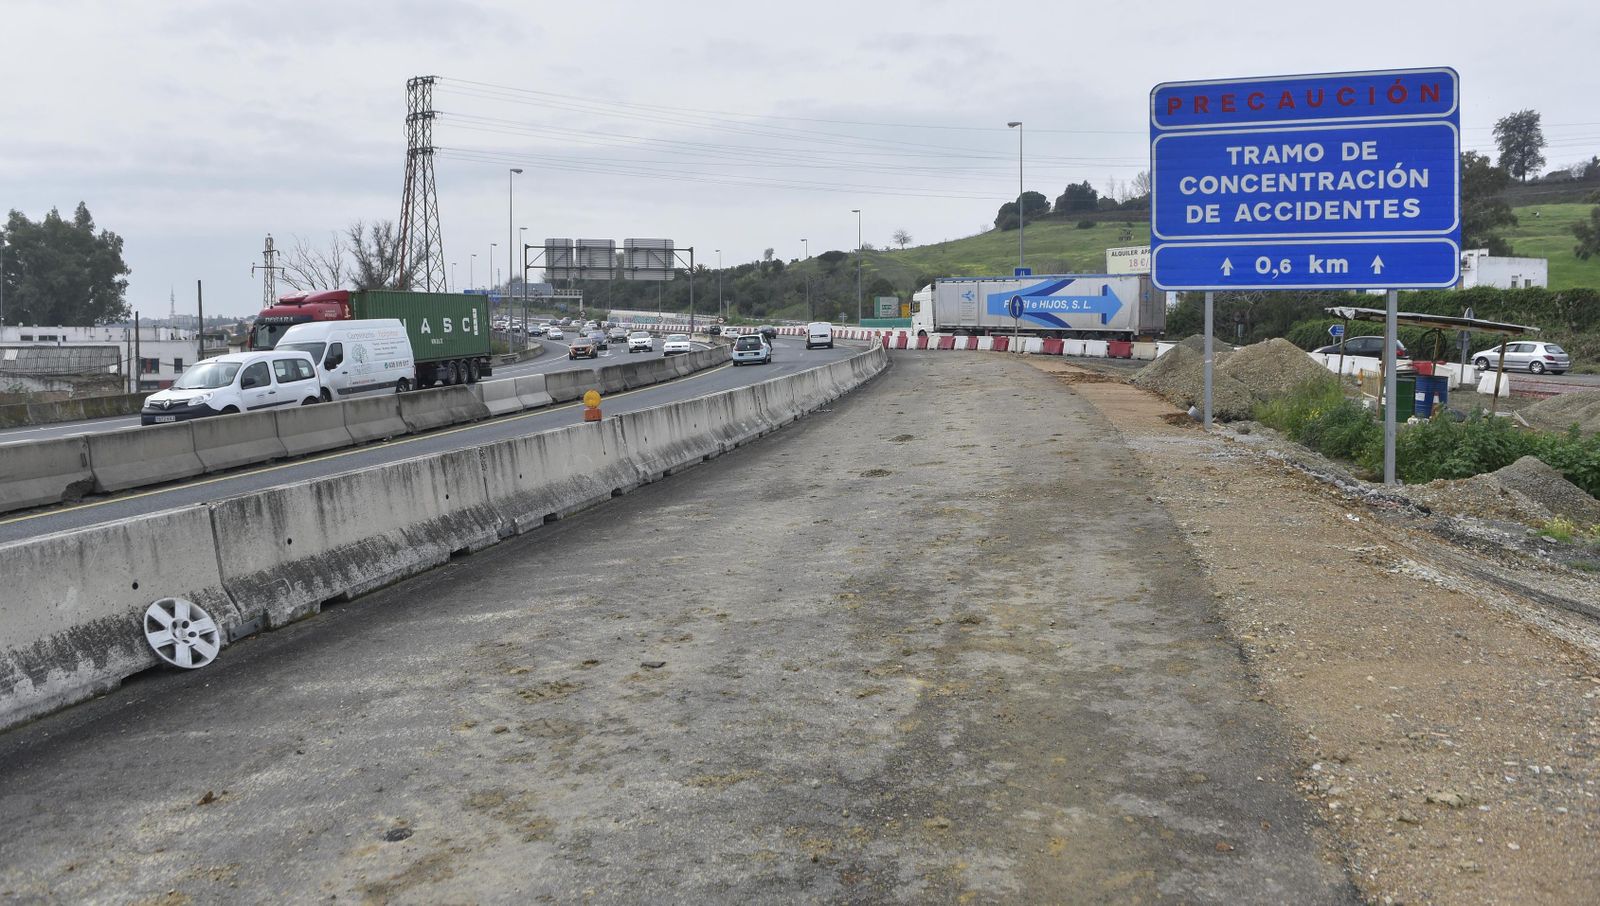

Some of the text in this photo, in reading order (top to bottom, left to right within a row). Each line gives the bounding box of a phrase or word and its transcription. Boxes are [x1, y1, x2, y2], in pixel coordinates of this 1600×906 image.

[1167, 78, 1440, 115] PRECAUCIÓN
[1226, 141, 1378, 166] TRAMO DE
[1179, 162, 1429, 195] CONCENTRACIÓN
[1186, 198, 1421, 224] DE ACCIDENTES
[1255, 254, 1349, 279] 0,6 km
[1039, 300, 1069, 310] HIJOS,
[1071, 300, 1081, 309] S.
[1083, 300, 1092, 309] L.
